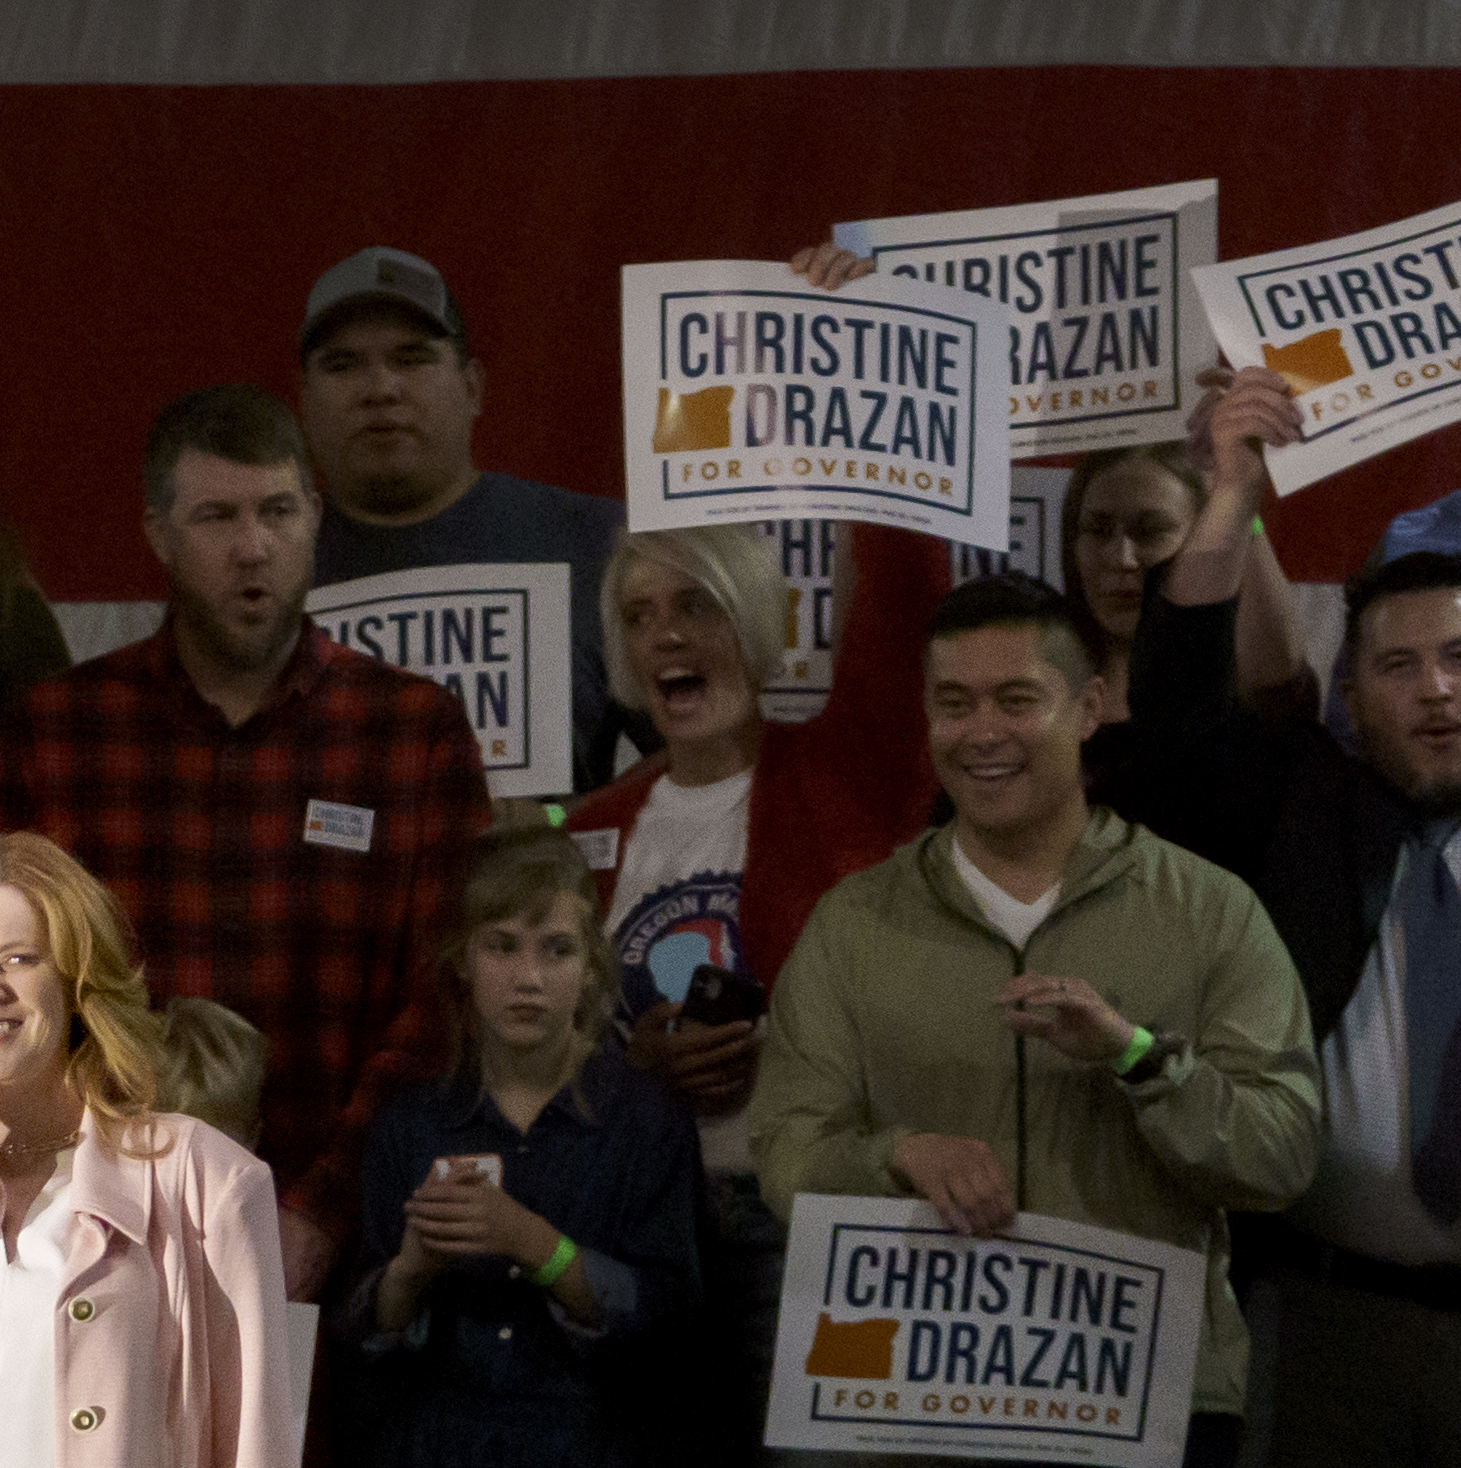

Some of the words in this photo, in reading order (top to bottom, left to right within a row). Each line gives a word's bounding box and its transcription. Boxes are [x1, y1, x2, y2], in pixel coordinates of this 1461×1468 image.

[893, 234, 1161, 314] RISTINE
[679, 311, 960, 396] CHRISTINE
[745, 384, 956, 467] DRAZAN
[1312, 384, 1374, 421] FOR
[682, 460, 743, 483] FOR
[763, 456, 954, 496] GOVERNOR
[845, 1244, 1142, 1334] CHRISTINE
[906, 1318, 1134, 1398] DRAZAN
[834, 1389, 900, 1412] FOR
[922, 1393, 1122, 1426] GOVERNOR
